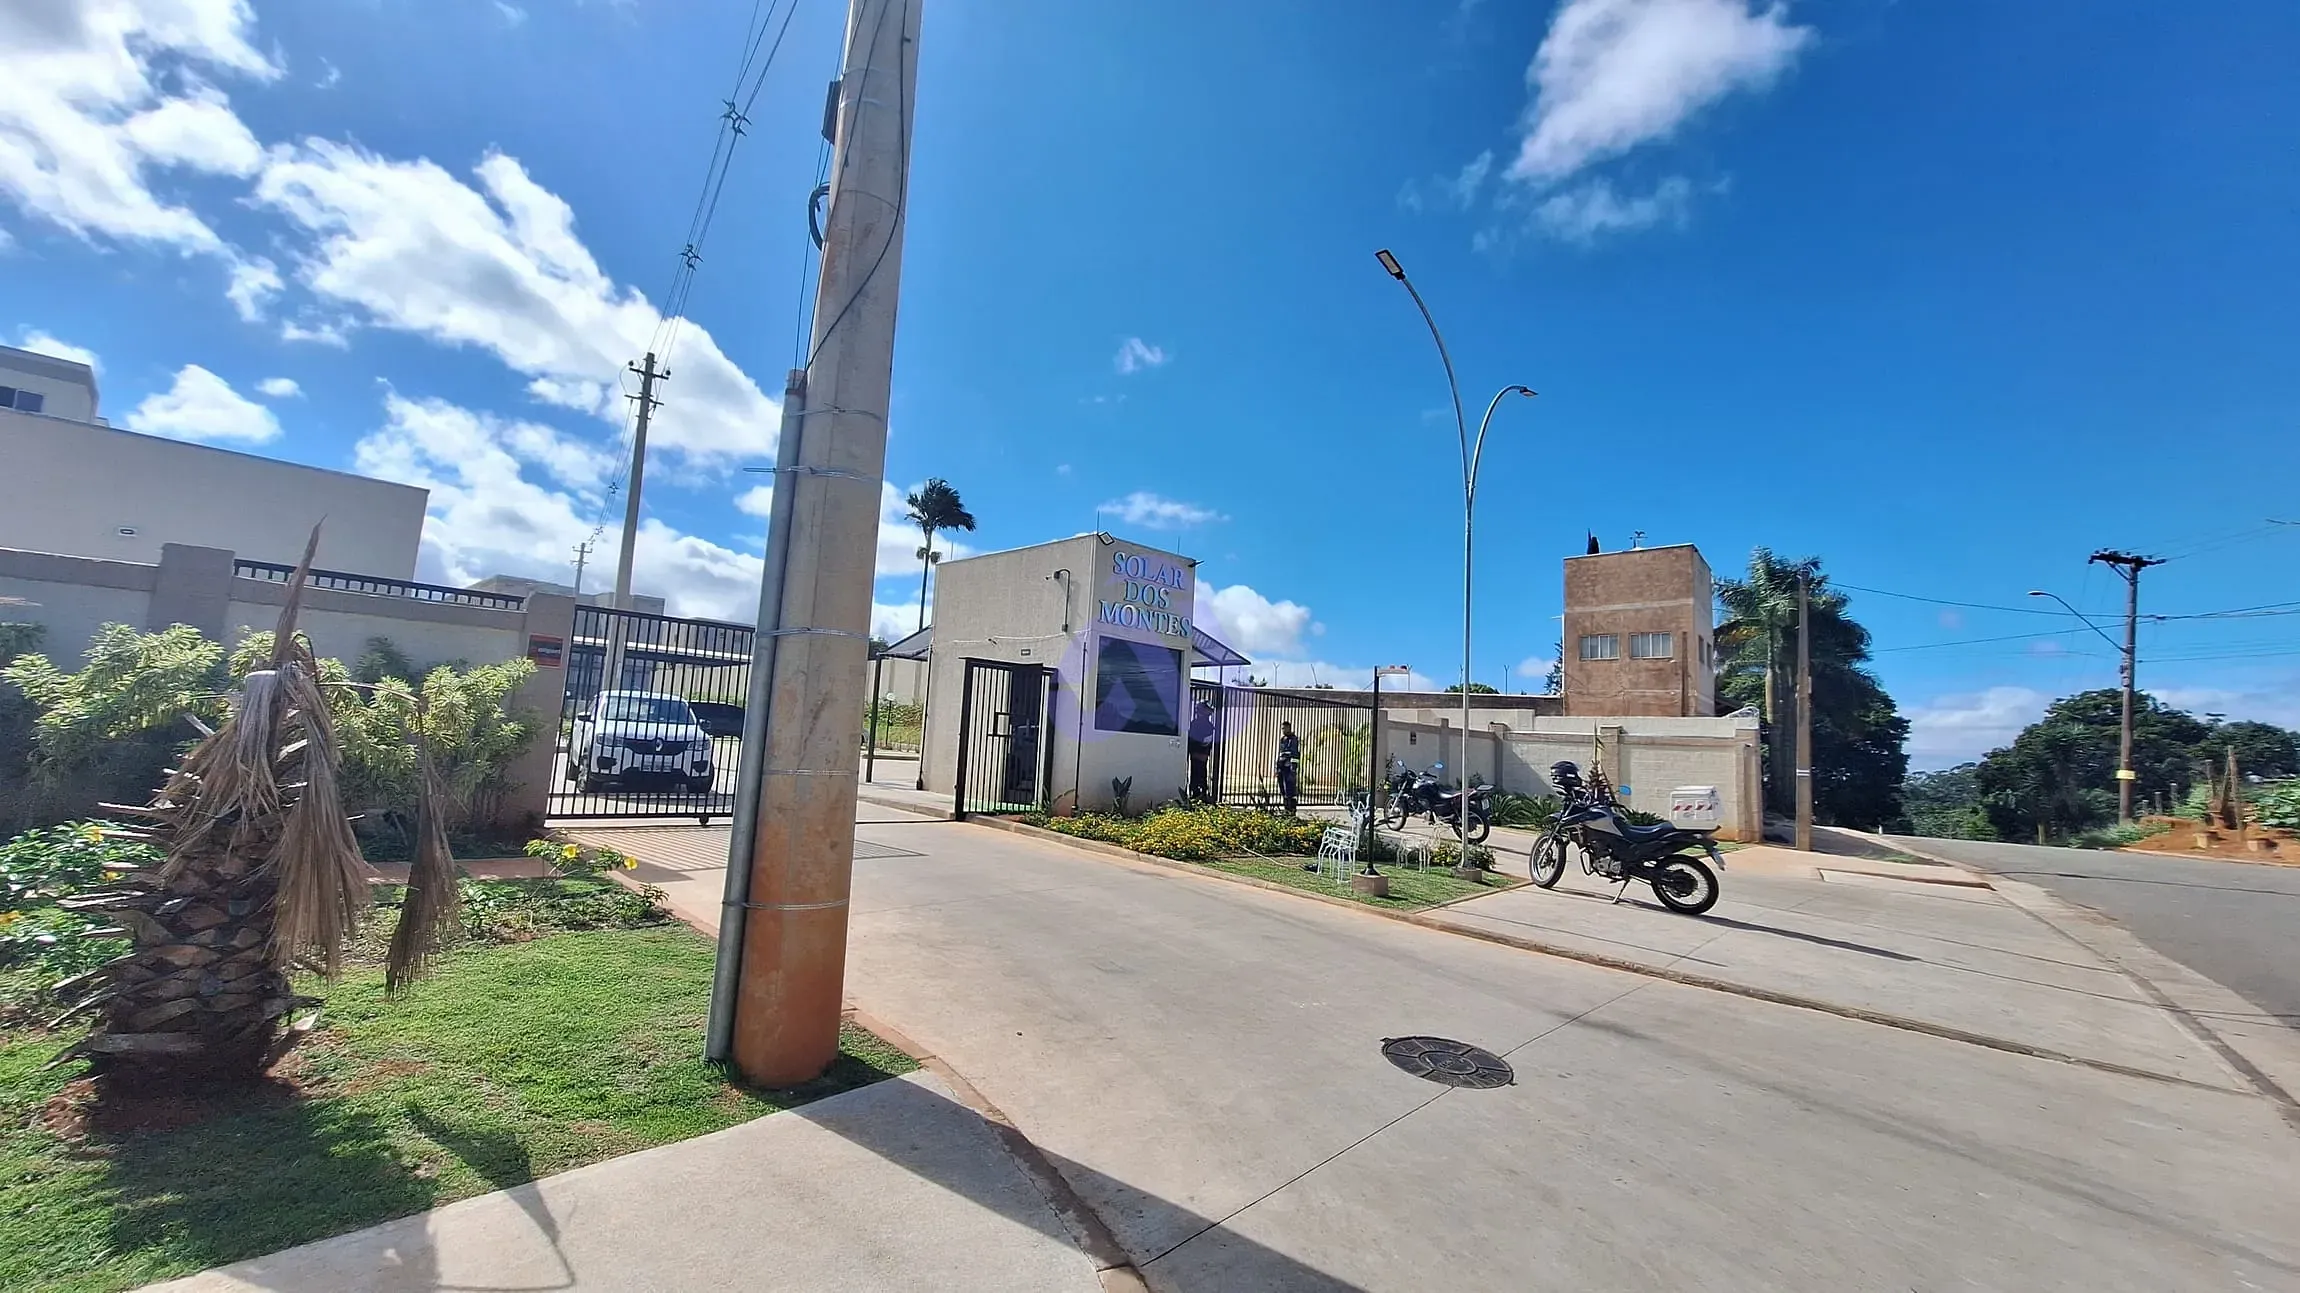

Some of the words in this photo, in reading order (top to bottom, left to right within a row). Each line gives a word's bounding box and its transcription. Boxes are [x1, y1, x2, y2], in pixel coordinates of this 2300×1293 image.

[1112, 551, 1185, 589] SOLAR
[1123, 579, 1169, 609] DOS
[1099, 600, 1192, 638] MONTES
